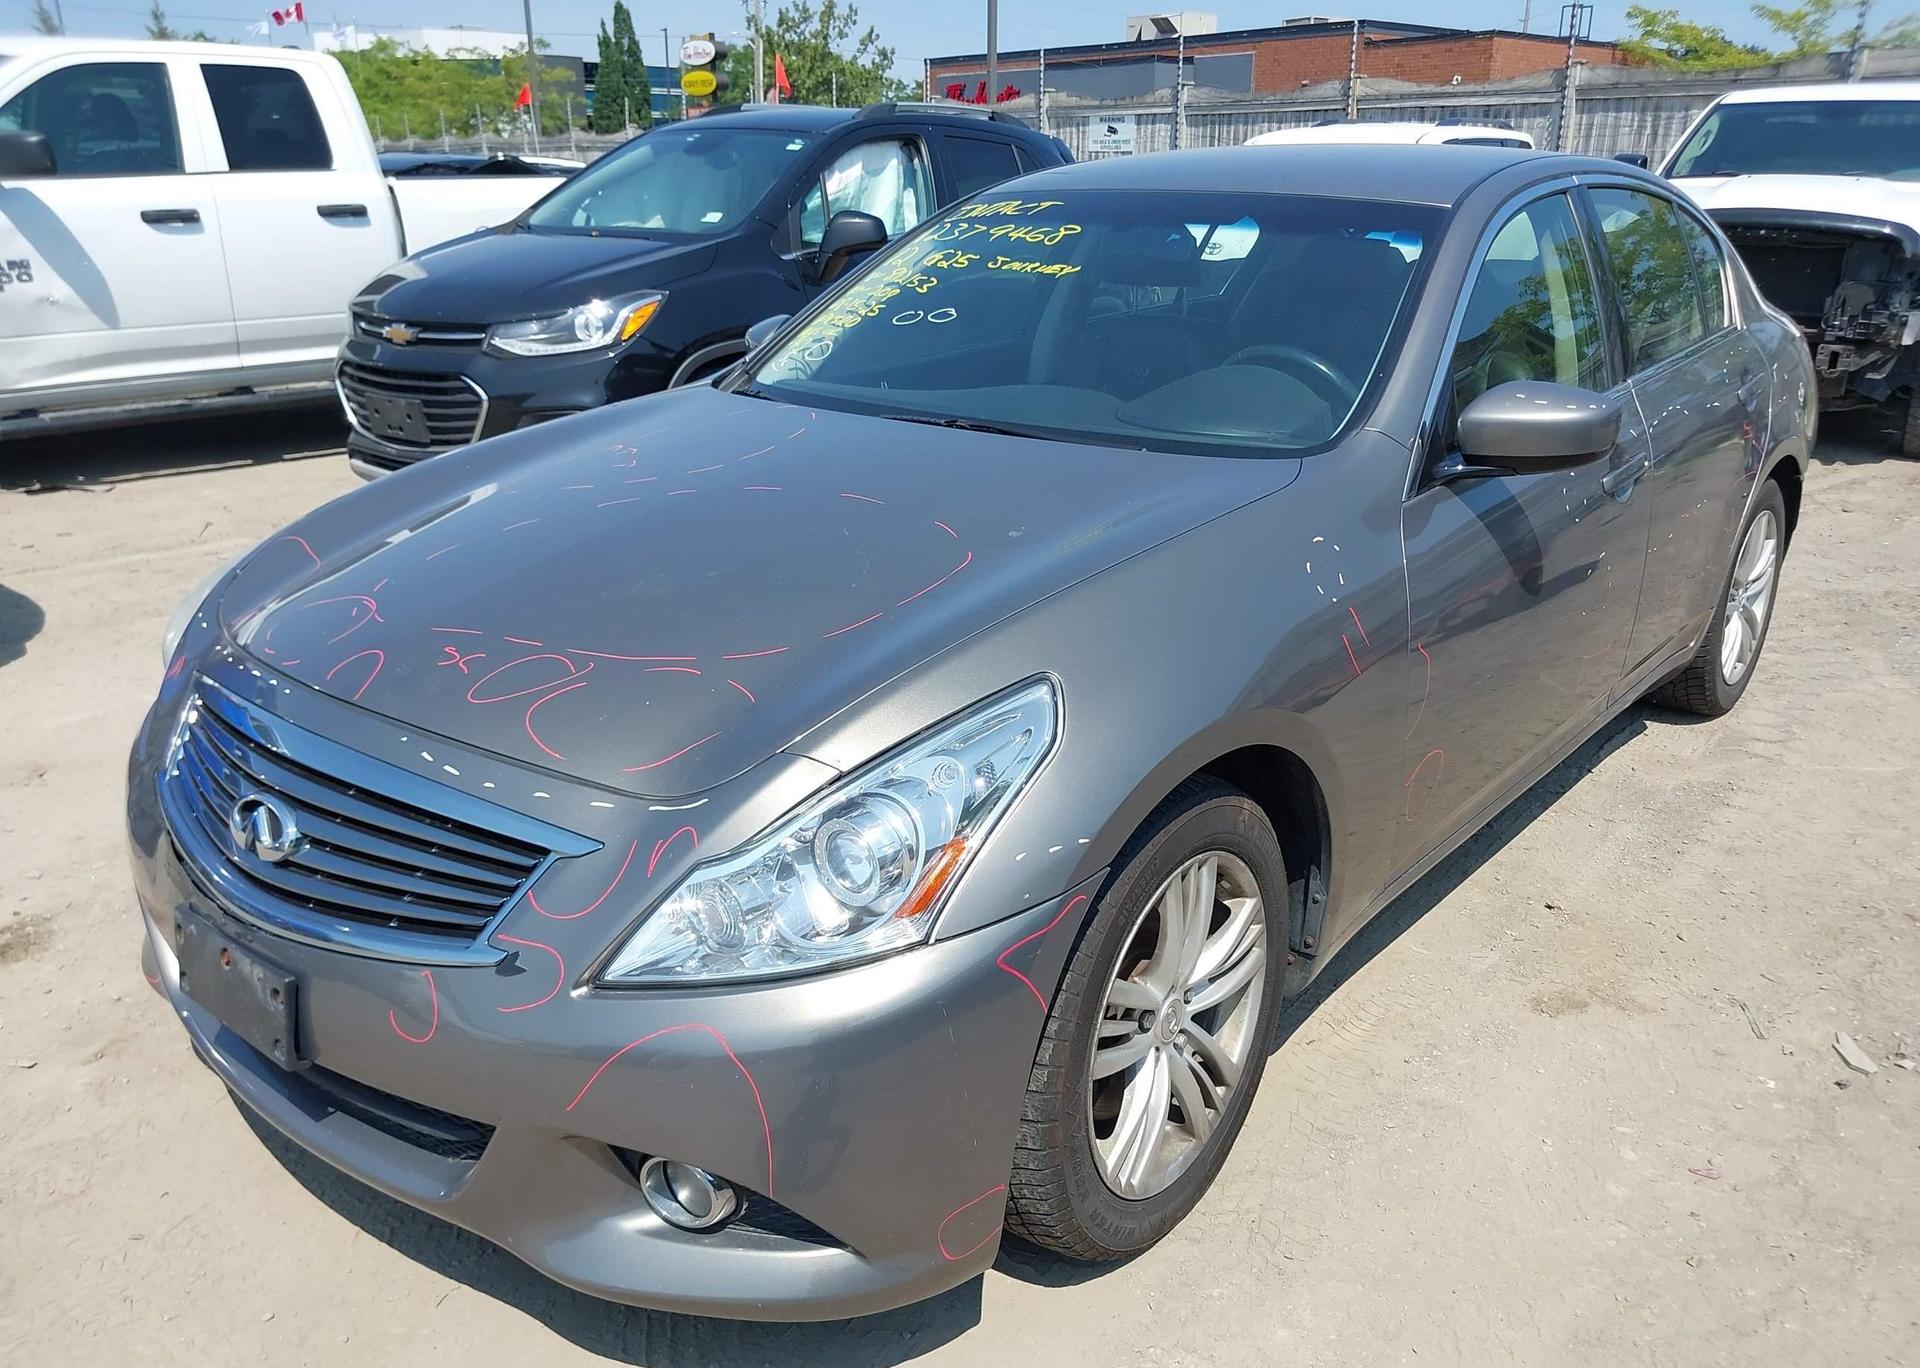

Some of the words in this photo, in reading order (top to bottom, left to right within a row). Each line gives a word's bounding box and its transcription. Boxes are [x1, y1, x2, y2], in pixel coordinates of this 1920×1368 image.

[944, 200, 1065, 223] INTACT
[922, 249, 981, 269] G25
[987, 255, 1082, 279] JOURNEY
